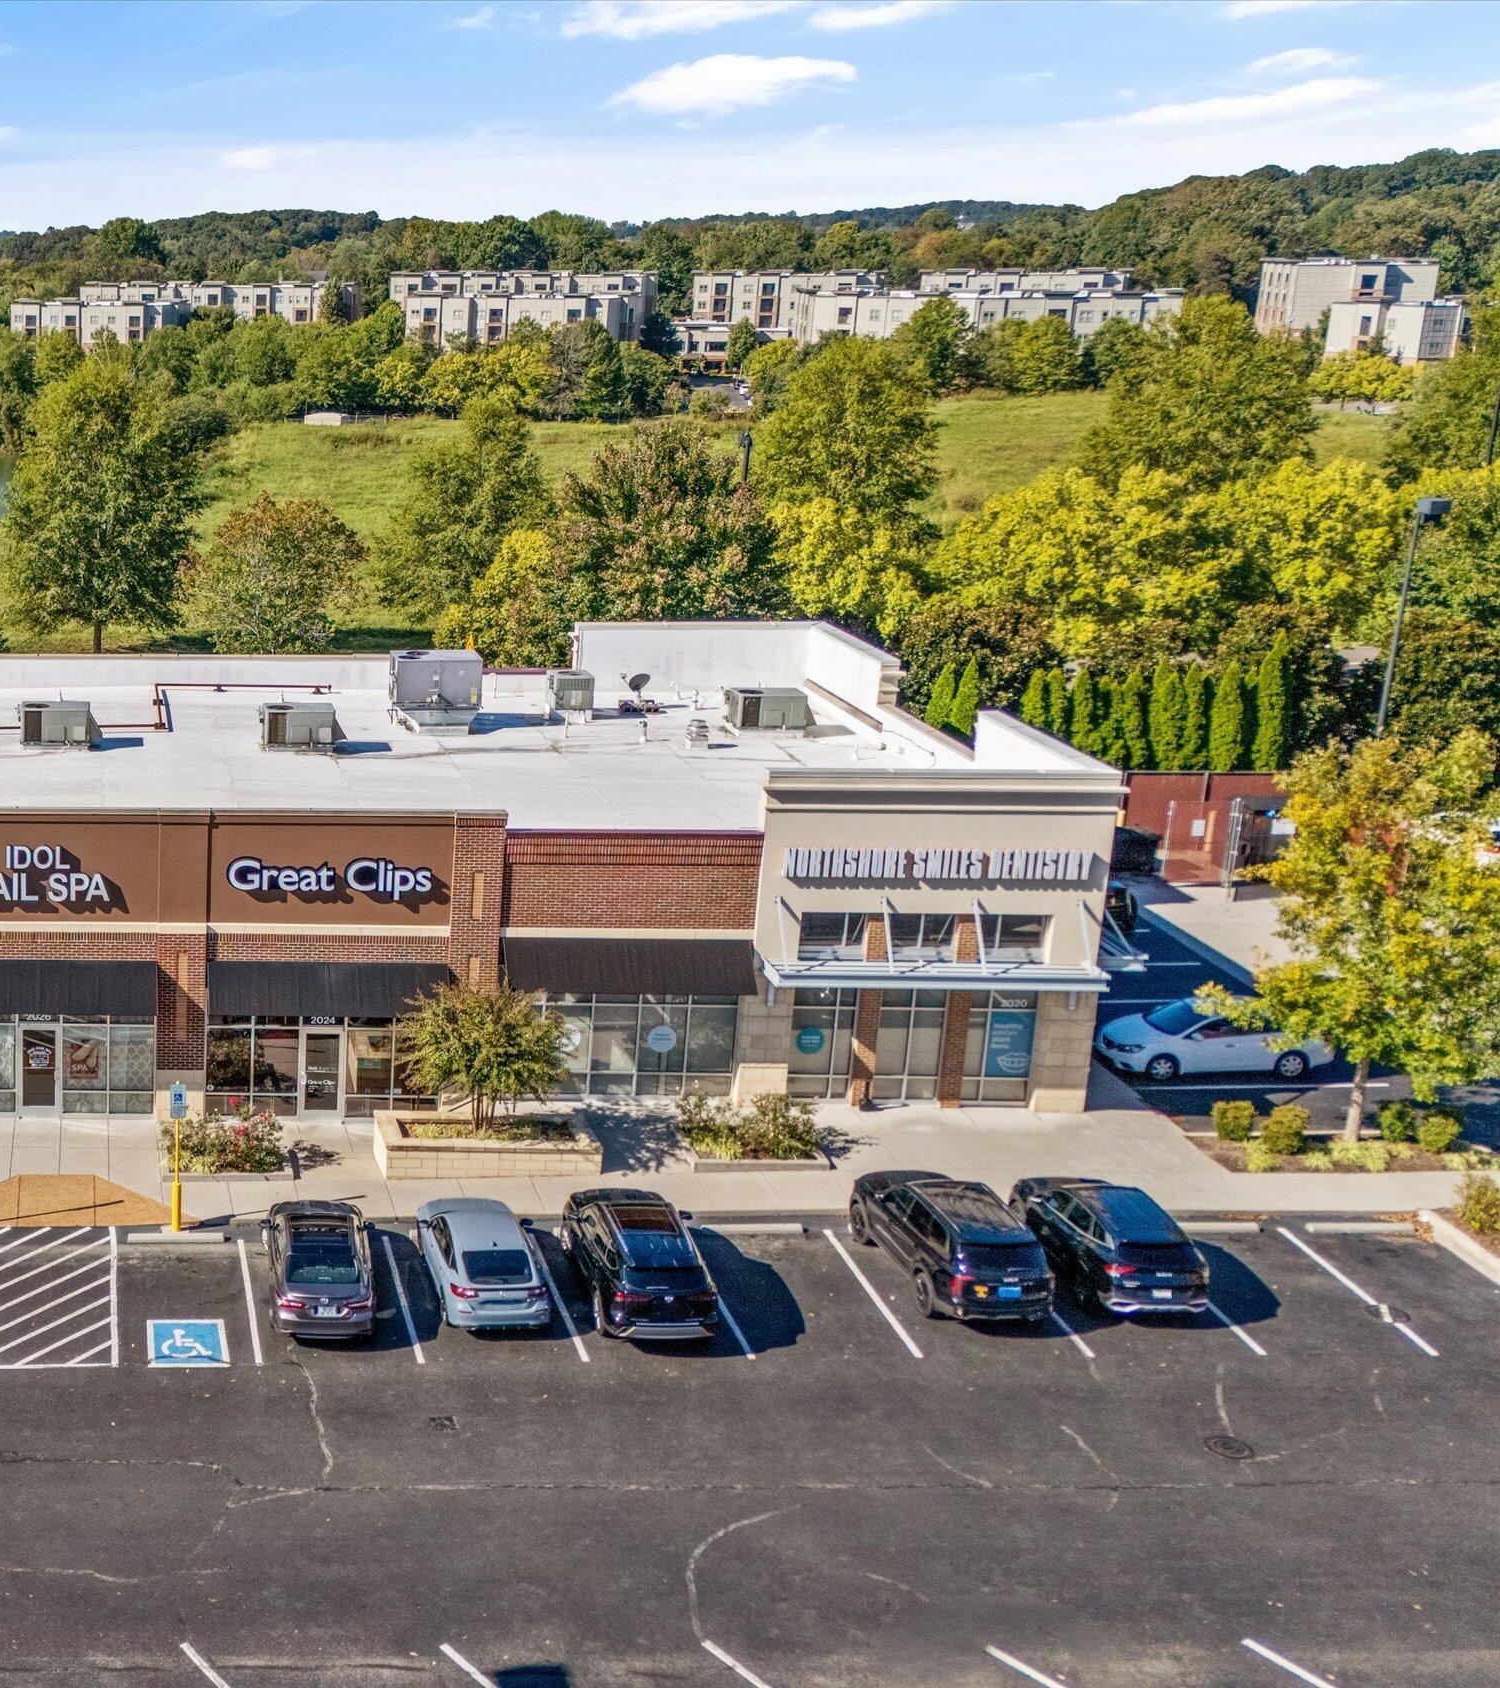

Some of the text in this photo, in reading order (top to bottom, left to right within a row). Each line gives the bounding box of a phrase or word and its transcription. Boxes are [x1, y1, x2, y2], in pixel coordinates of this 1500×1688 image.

[5, 845, 70, 869] IDOL
[782, 847, 1095, 880] NORTHSHORE SMILES DENTISTRY
[47, 872, 110, 902] SPA
[228, 857, 432, 900] Great Clips
[26, 1013, 51, 1021] 2026
[310, 1016, 336, 1025] 2024
[71, 1063, 88, 1072] SPA
